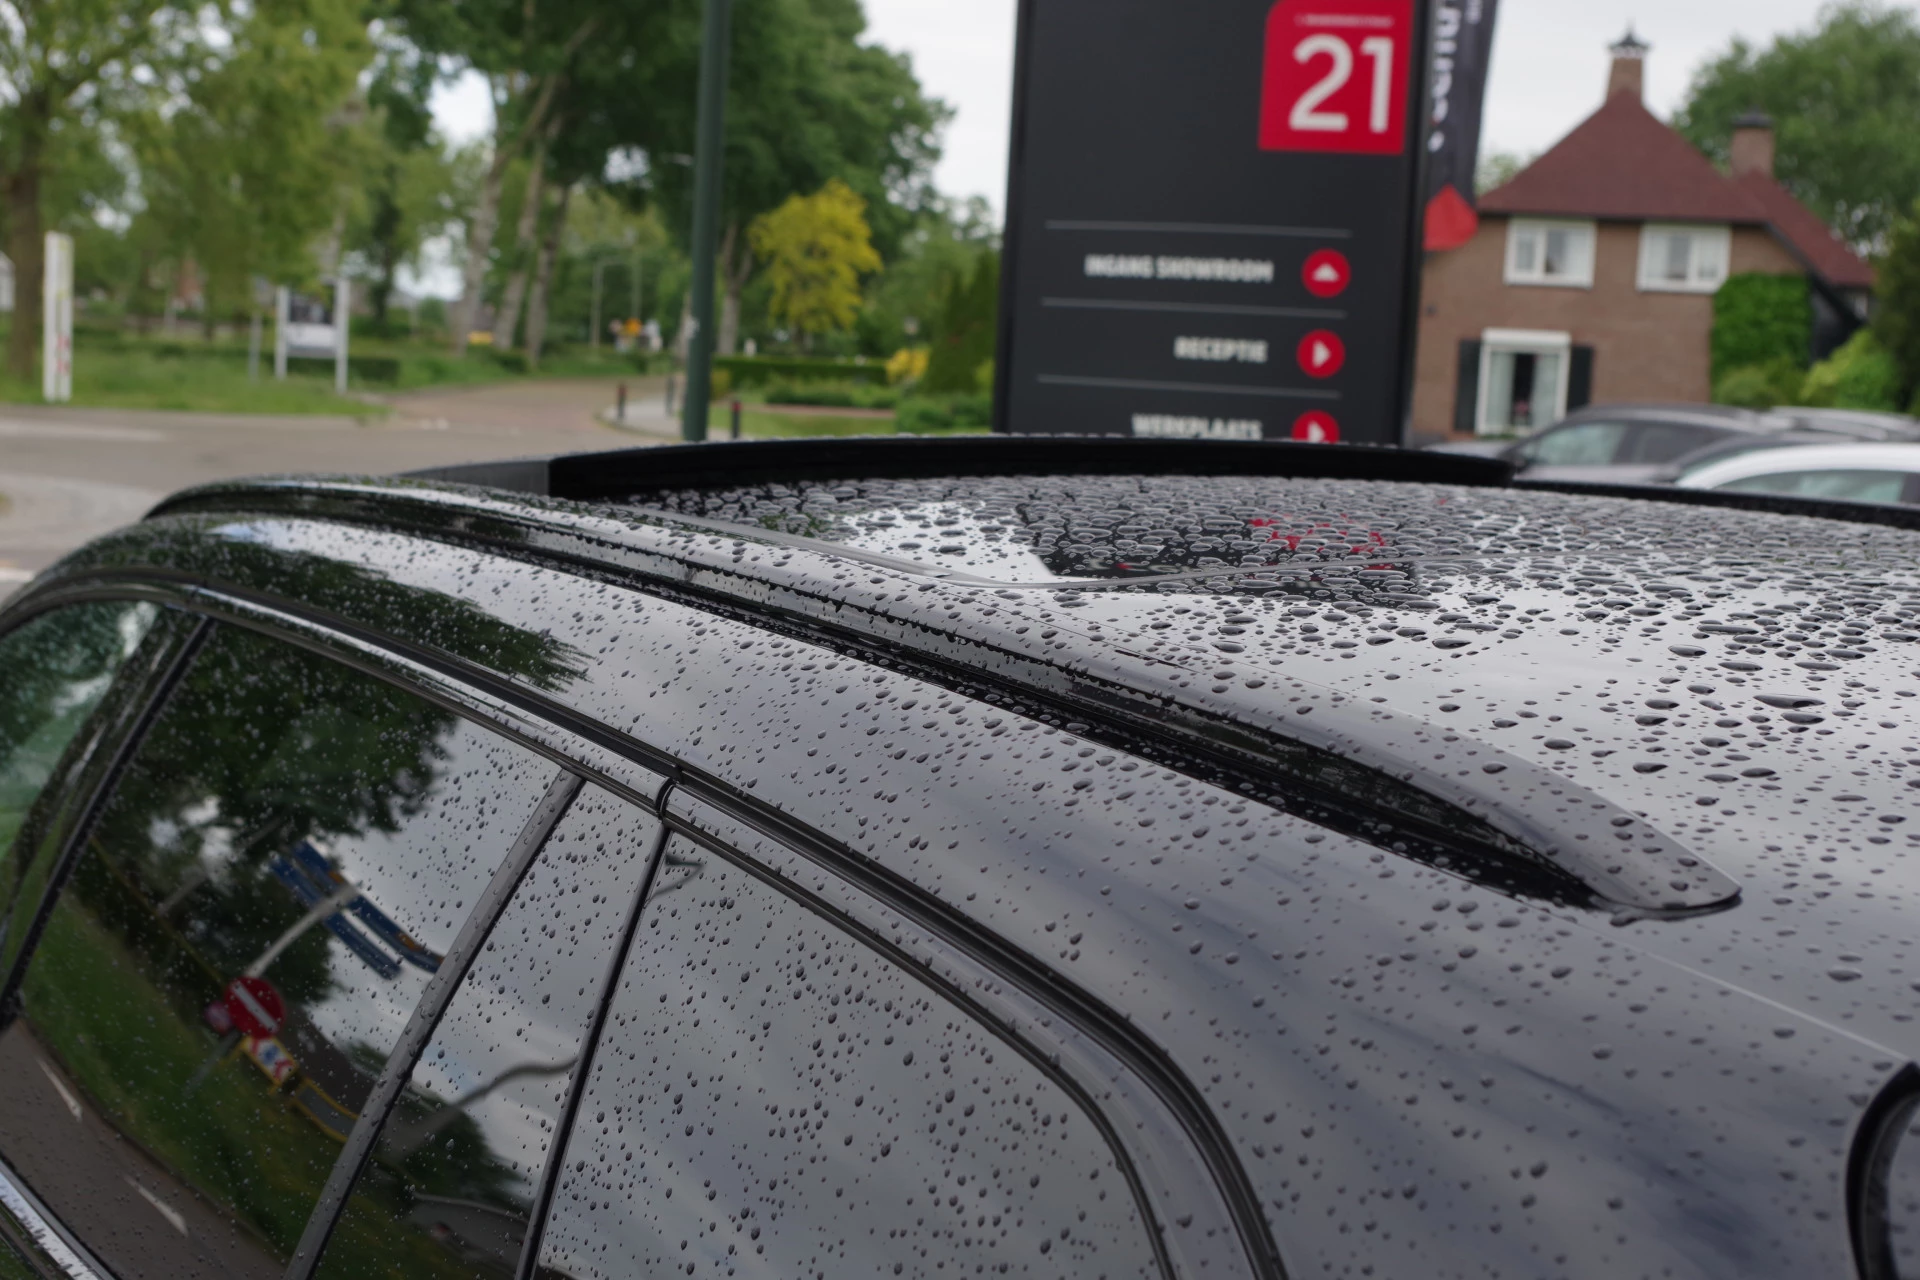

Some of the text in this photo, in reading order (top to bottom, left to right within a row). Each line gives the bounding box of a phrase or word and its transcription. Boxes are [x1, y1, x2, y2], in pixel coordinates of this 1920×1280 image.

[1289, 33, 1394, 133] 21
[1156, 256, 1274, 282] SHOWROOM
[1174, 336, 1268, 363] RECEPTIE
[1132, 413, 1262, 440] WERKPLAATS
